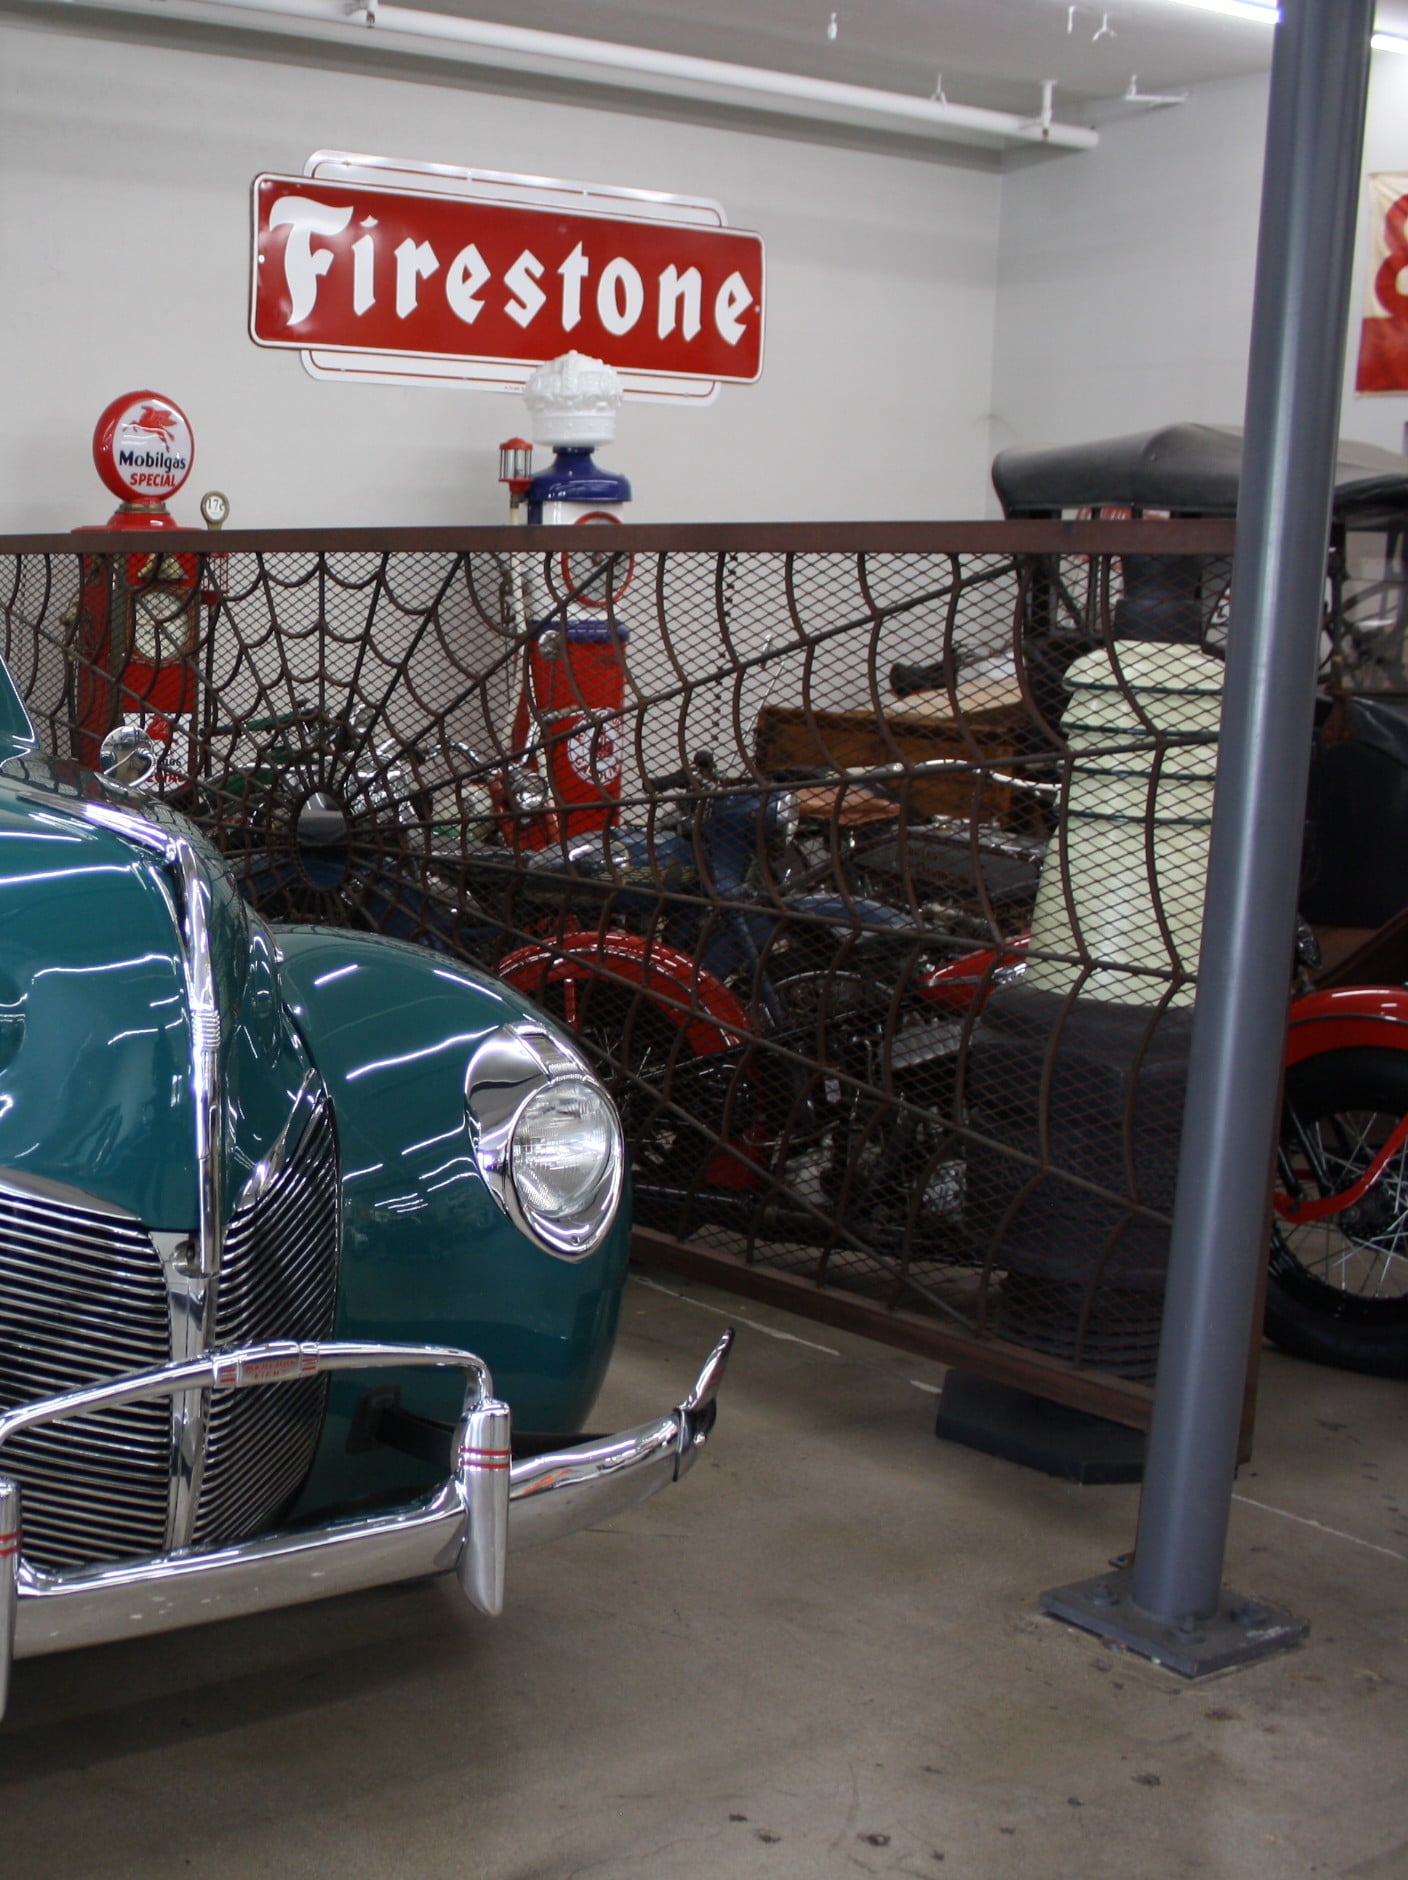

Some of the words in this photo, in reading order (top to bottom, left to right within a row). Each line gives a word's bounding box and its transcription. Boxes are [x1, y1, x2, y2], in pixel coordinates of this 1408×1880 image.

[268, 195, 754, 346] Firestone
[119, 449, 186, 473] Mobilgas
[129, 472, 176, 487] SPECIAL
